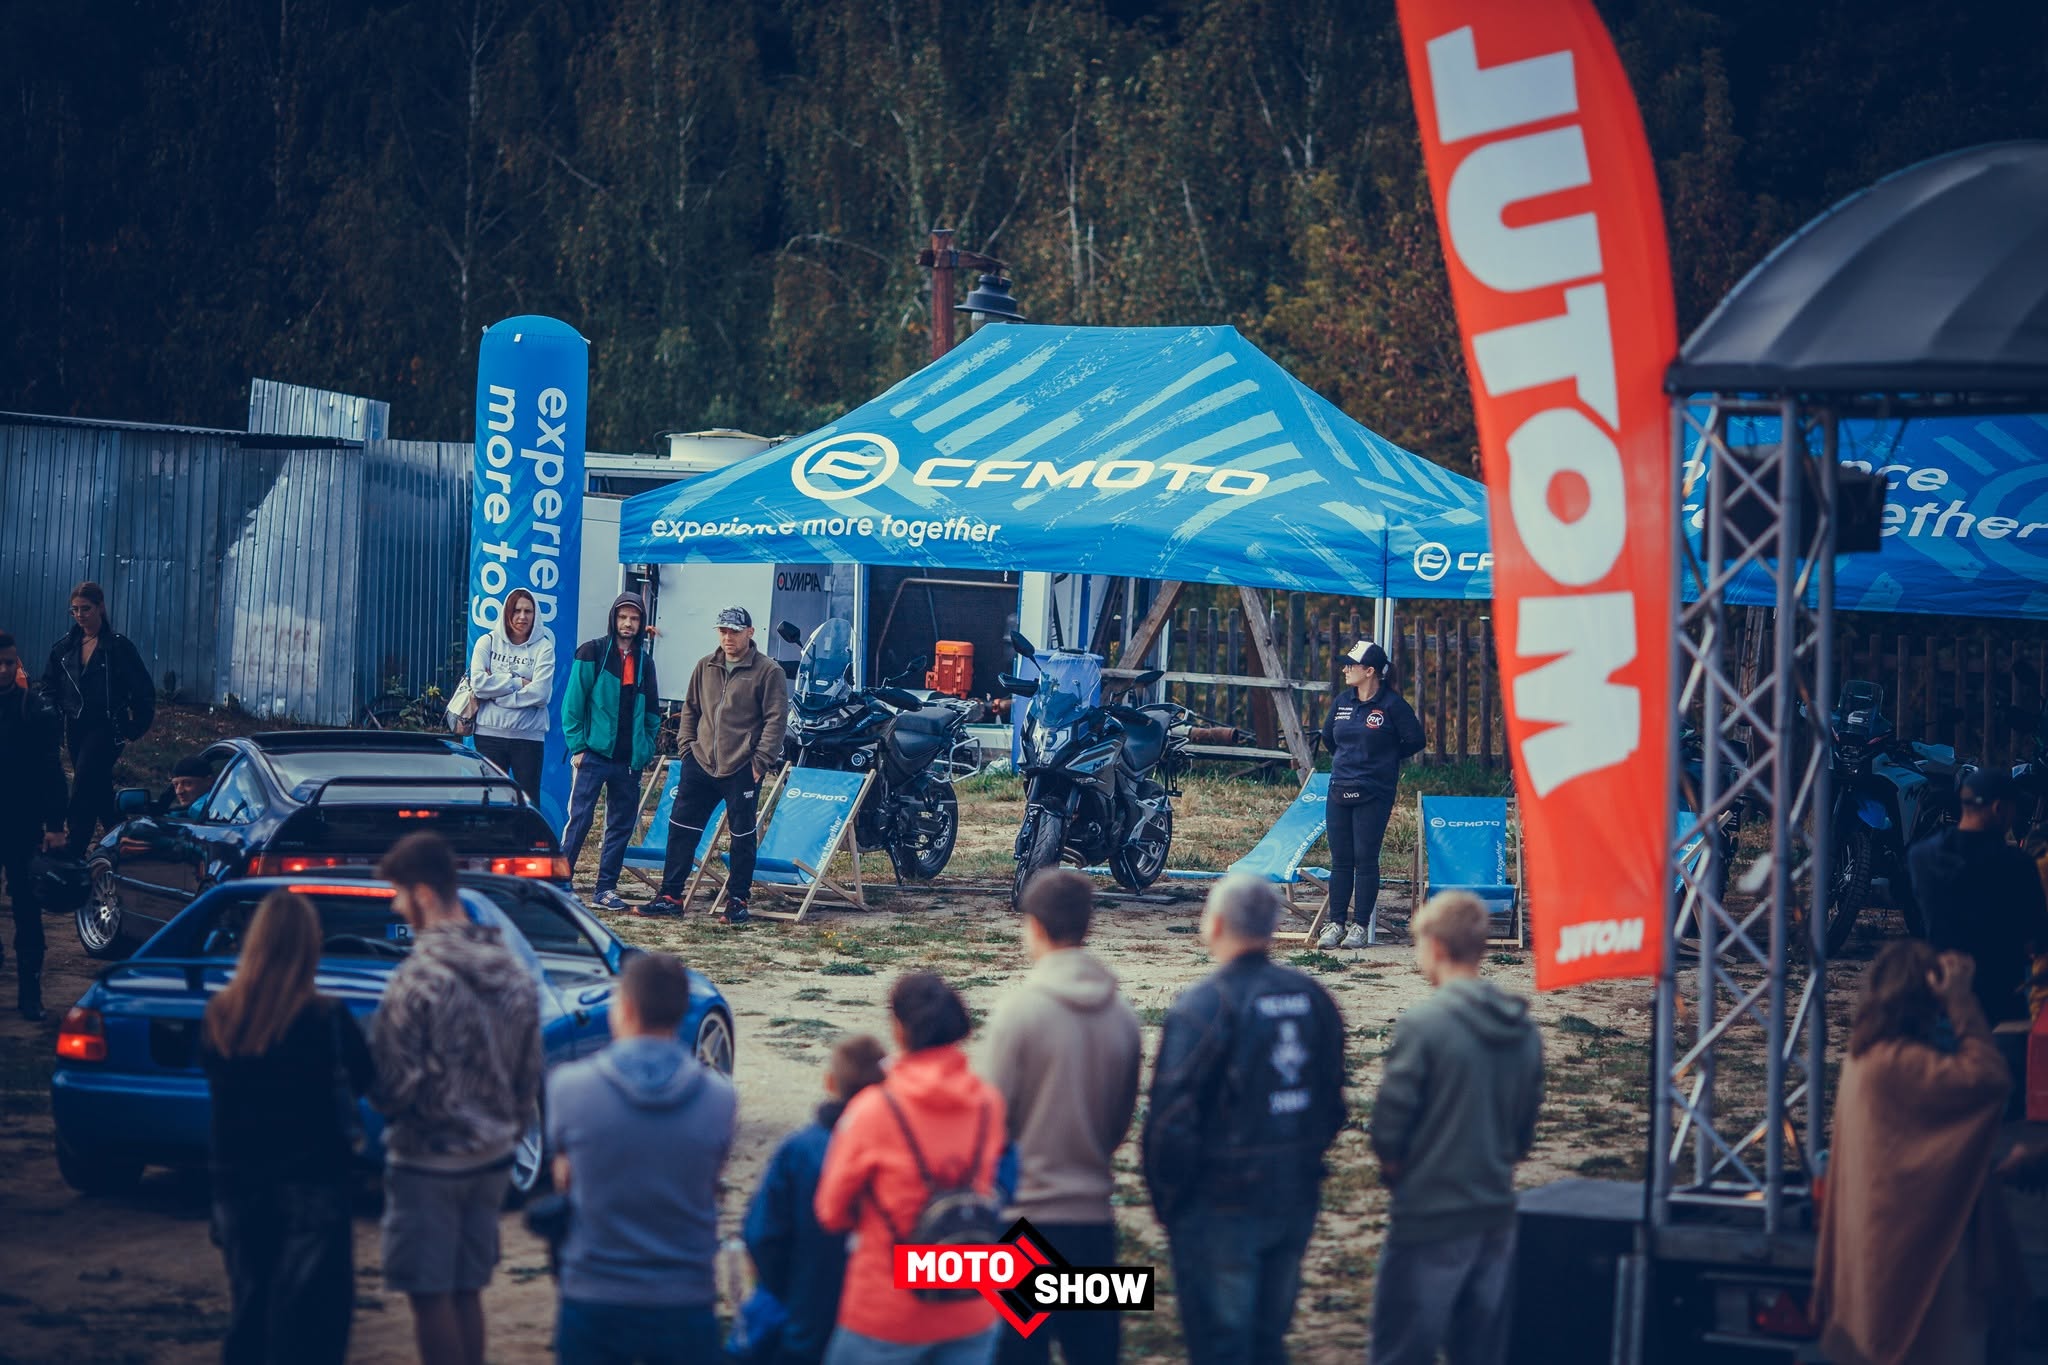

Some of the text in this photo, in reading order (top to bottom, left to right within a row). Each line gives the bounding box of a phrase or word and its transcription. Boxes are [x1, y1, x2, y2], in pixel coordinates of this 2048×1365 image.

[484, 384, 516, 524] more
[911, 458, 1270, 497] CFMOTO
[520, 387, 568, 647] experien
[802, 516, 873, 536] more
[881, 514, 1002, 547] together
[1880, 499, 2048, 540] ether
[777, 572, 822, 592] OLYMPIA
[801, 792, 848, 802] CFMOTO
[823, 816, 842, 852] together
